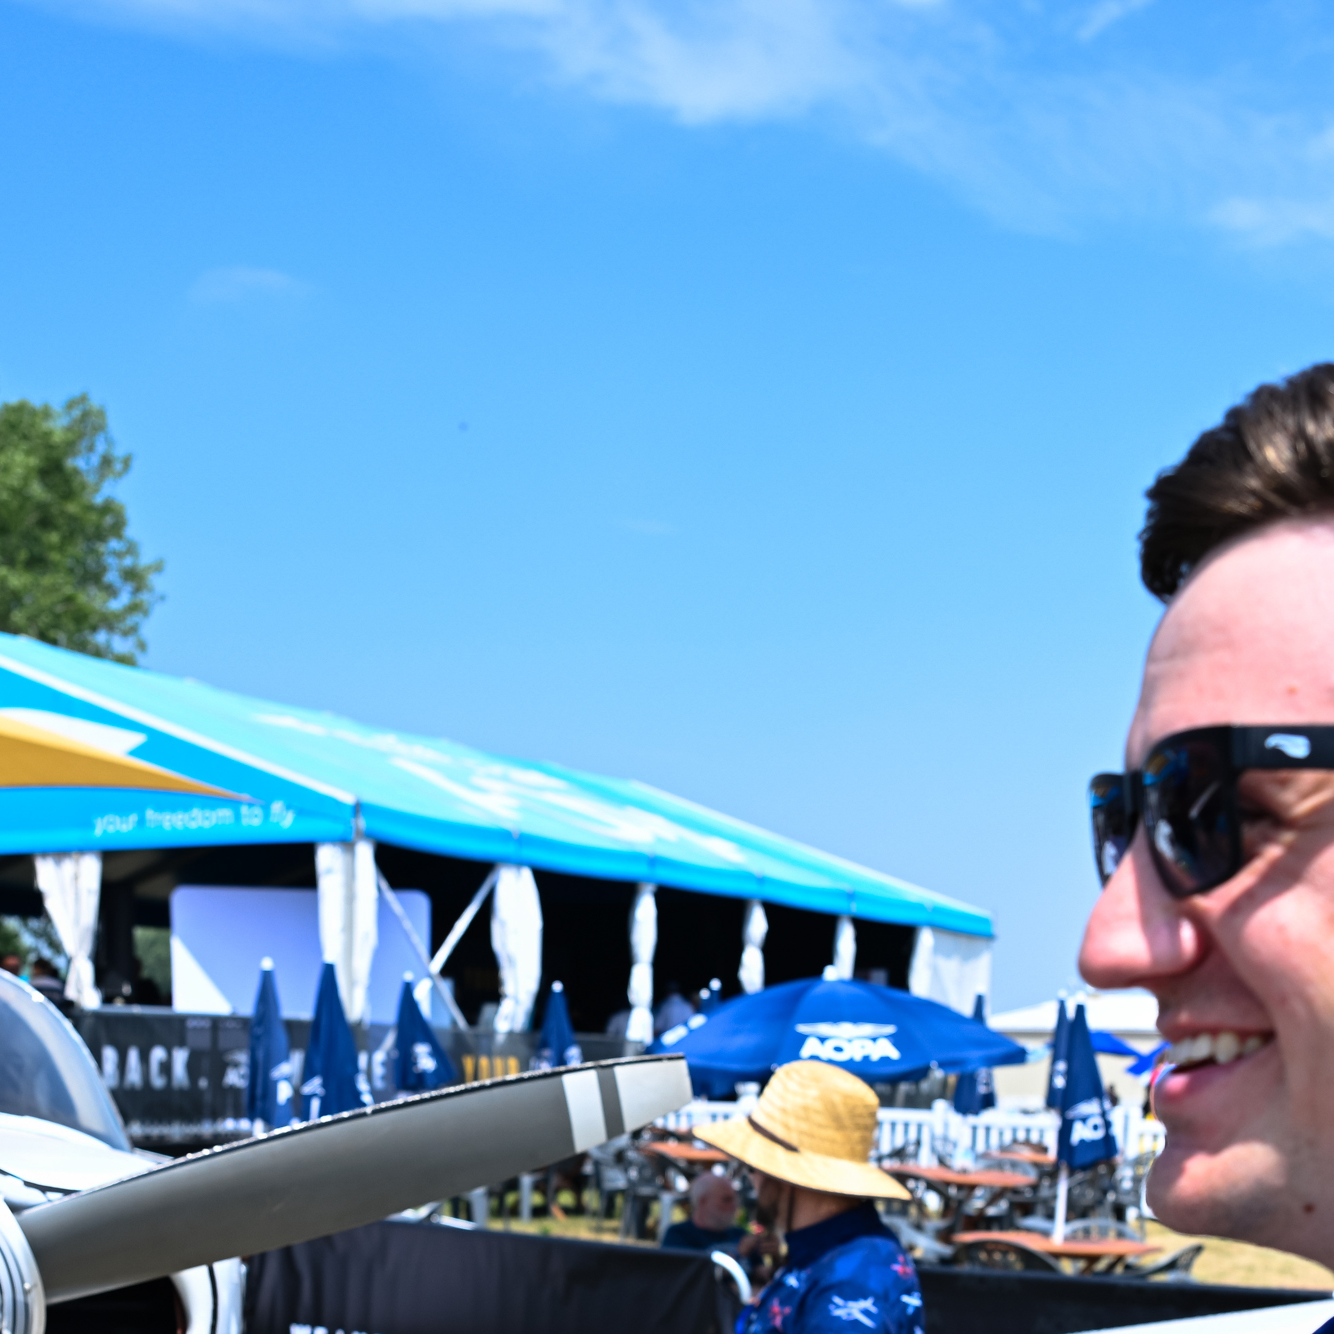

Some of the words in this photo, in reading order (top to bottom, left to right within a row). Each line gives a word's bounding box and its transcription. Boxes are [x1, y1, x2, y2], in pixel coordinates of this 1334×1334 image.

[93, 813, 138, 838] your
[145, 807, 235, 830] freedom
[799, 1035, 901, 1062] AOPA
